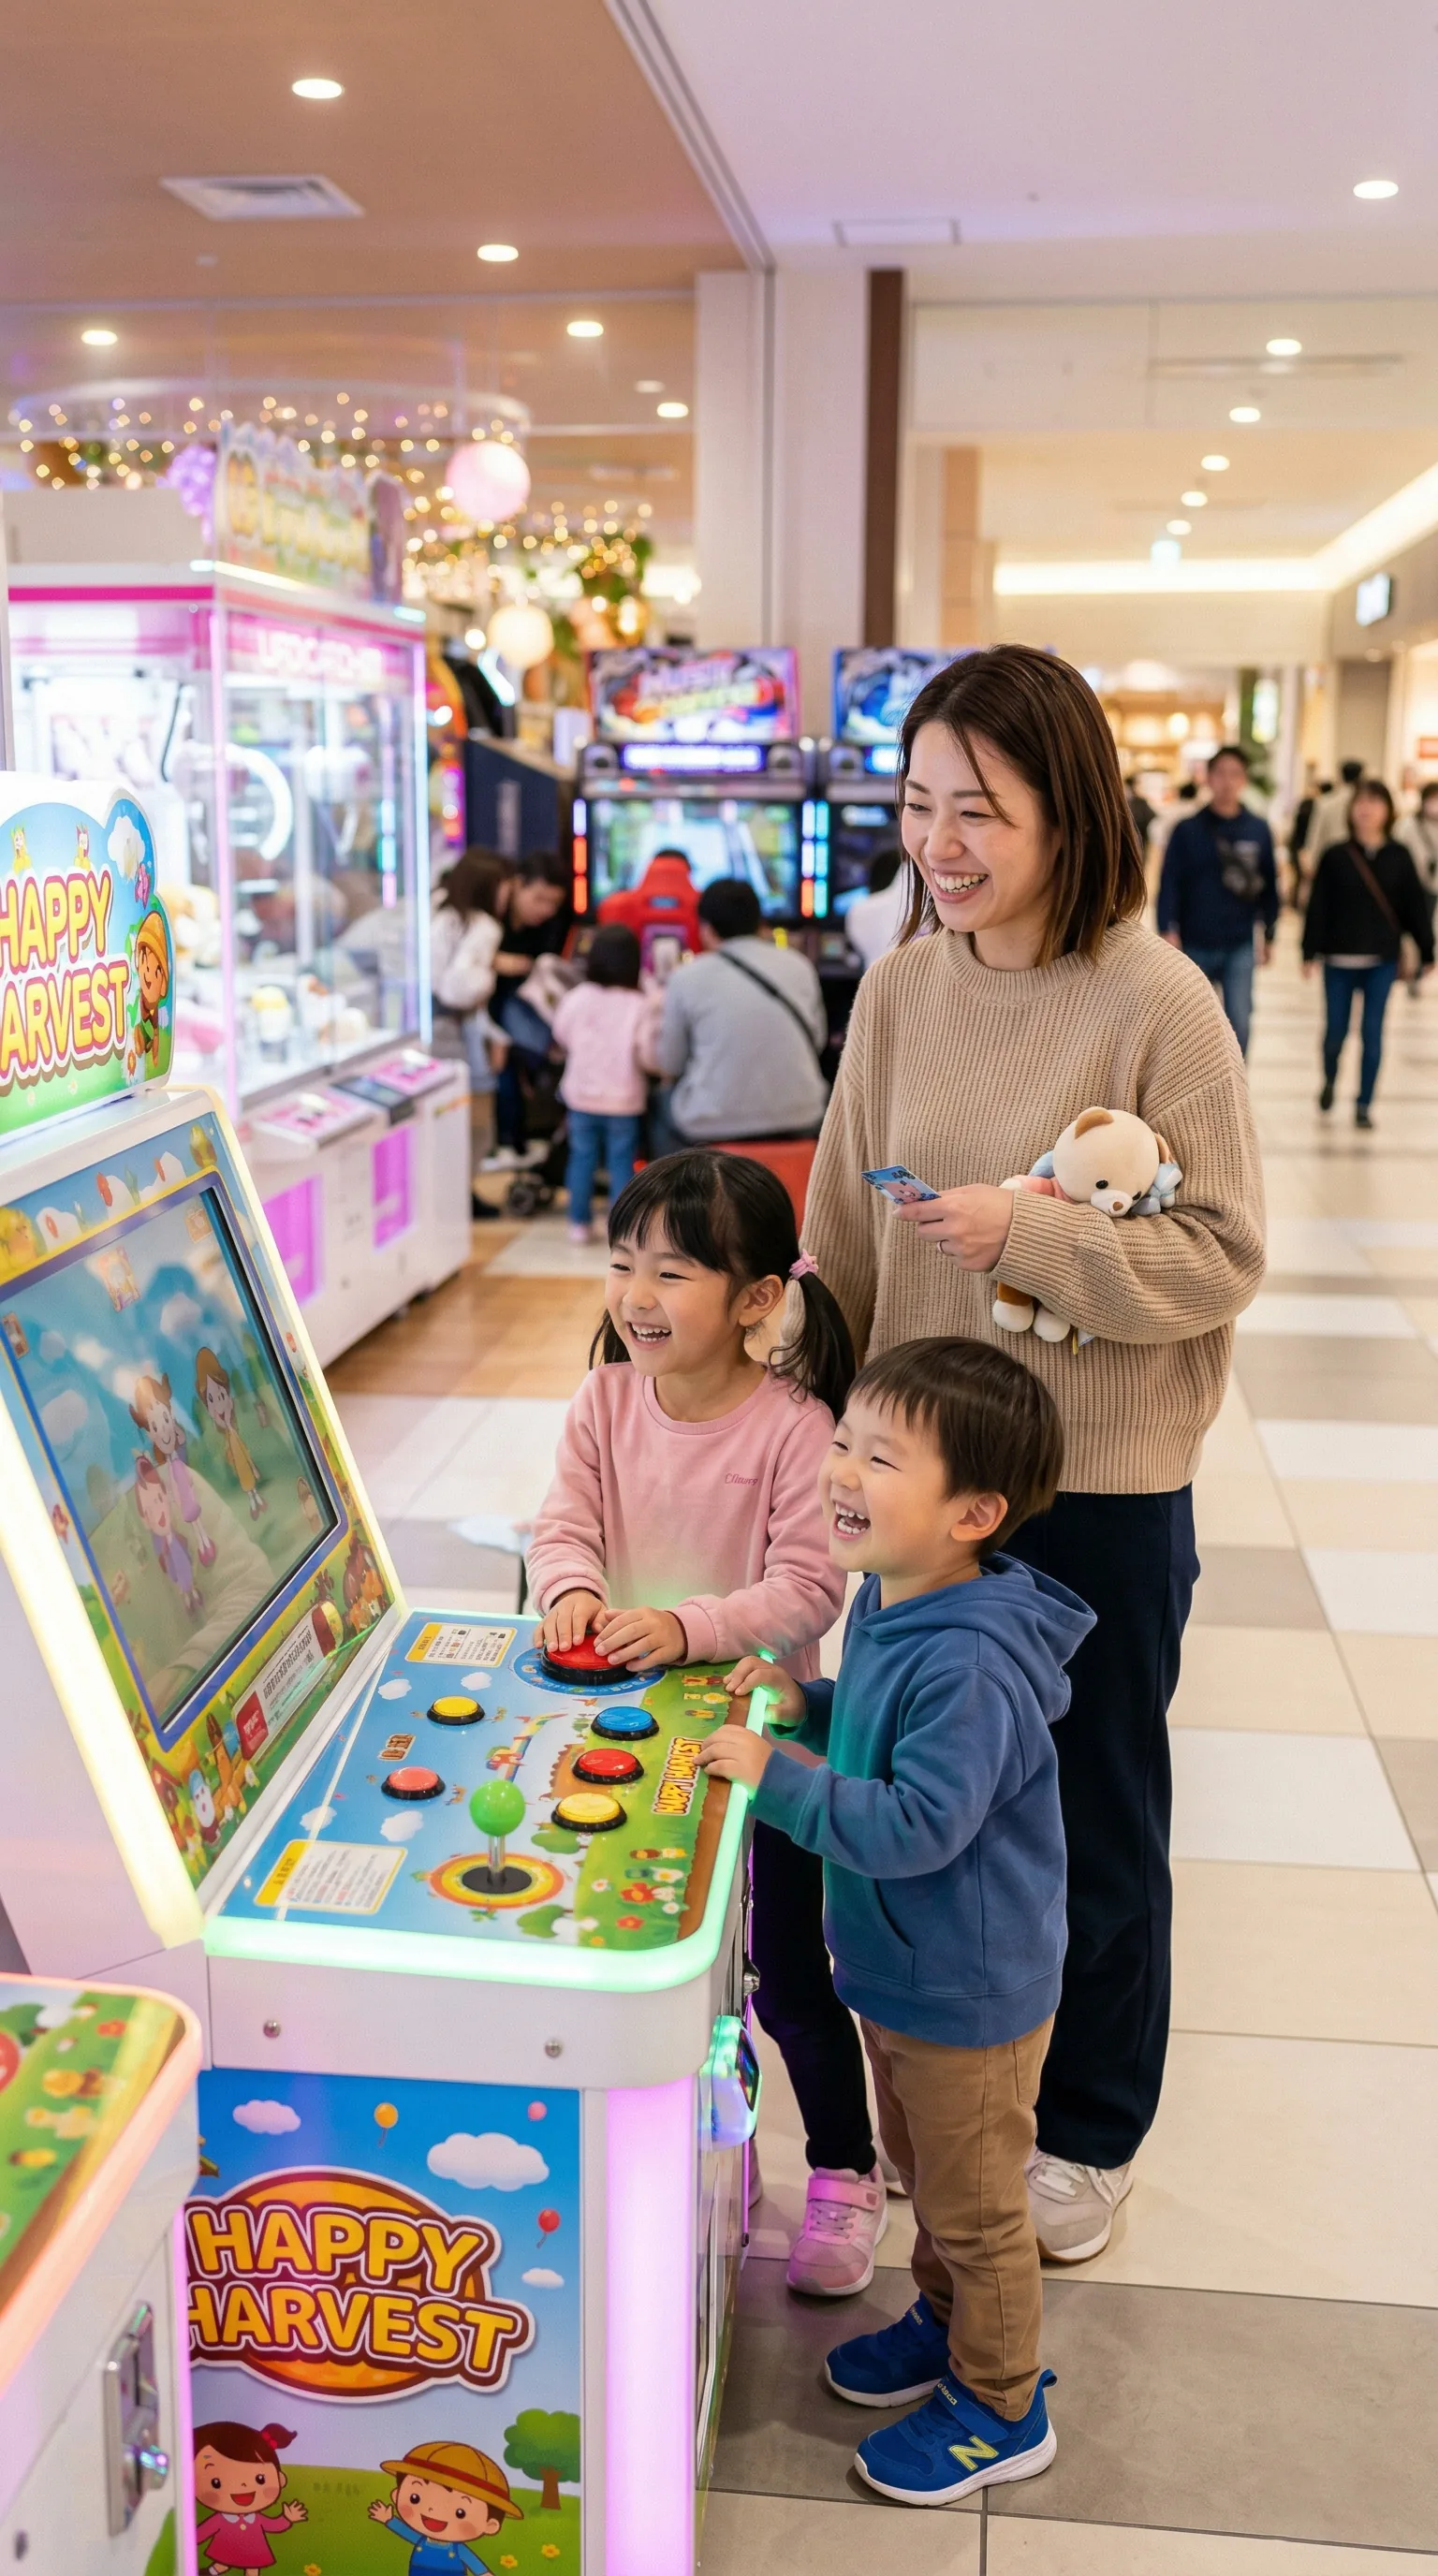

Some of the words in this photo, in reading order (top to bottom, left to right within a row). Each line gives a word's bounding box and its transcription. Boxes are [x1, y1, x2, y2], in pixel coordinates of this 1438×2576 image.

[0, 870, 111, 975] HAPPY
[0, 959, 128, 1079] ARVEST
[189, 2209, 484, 2292] HAPPY
[188, 2285, 516, 2372] HARVEST
[947, 2435, 999, 2471] N
